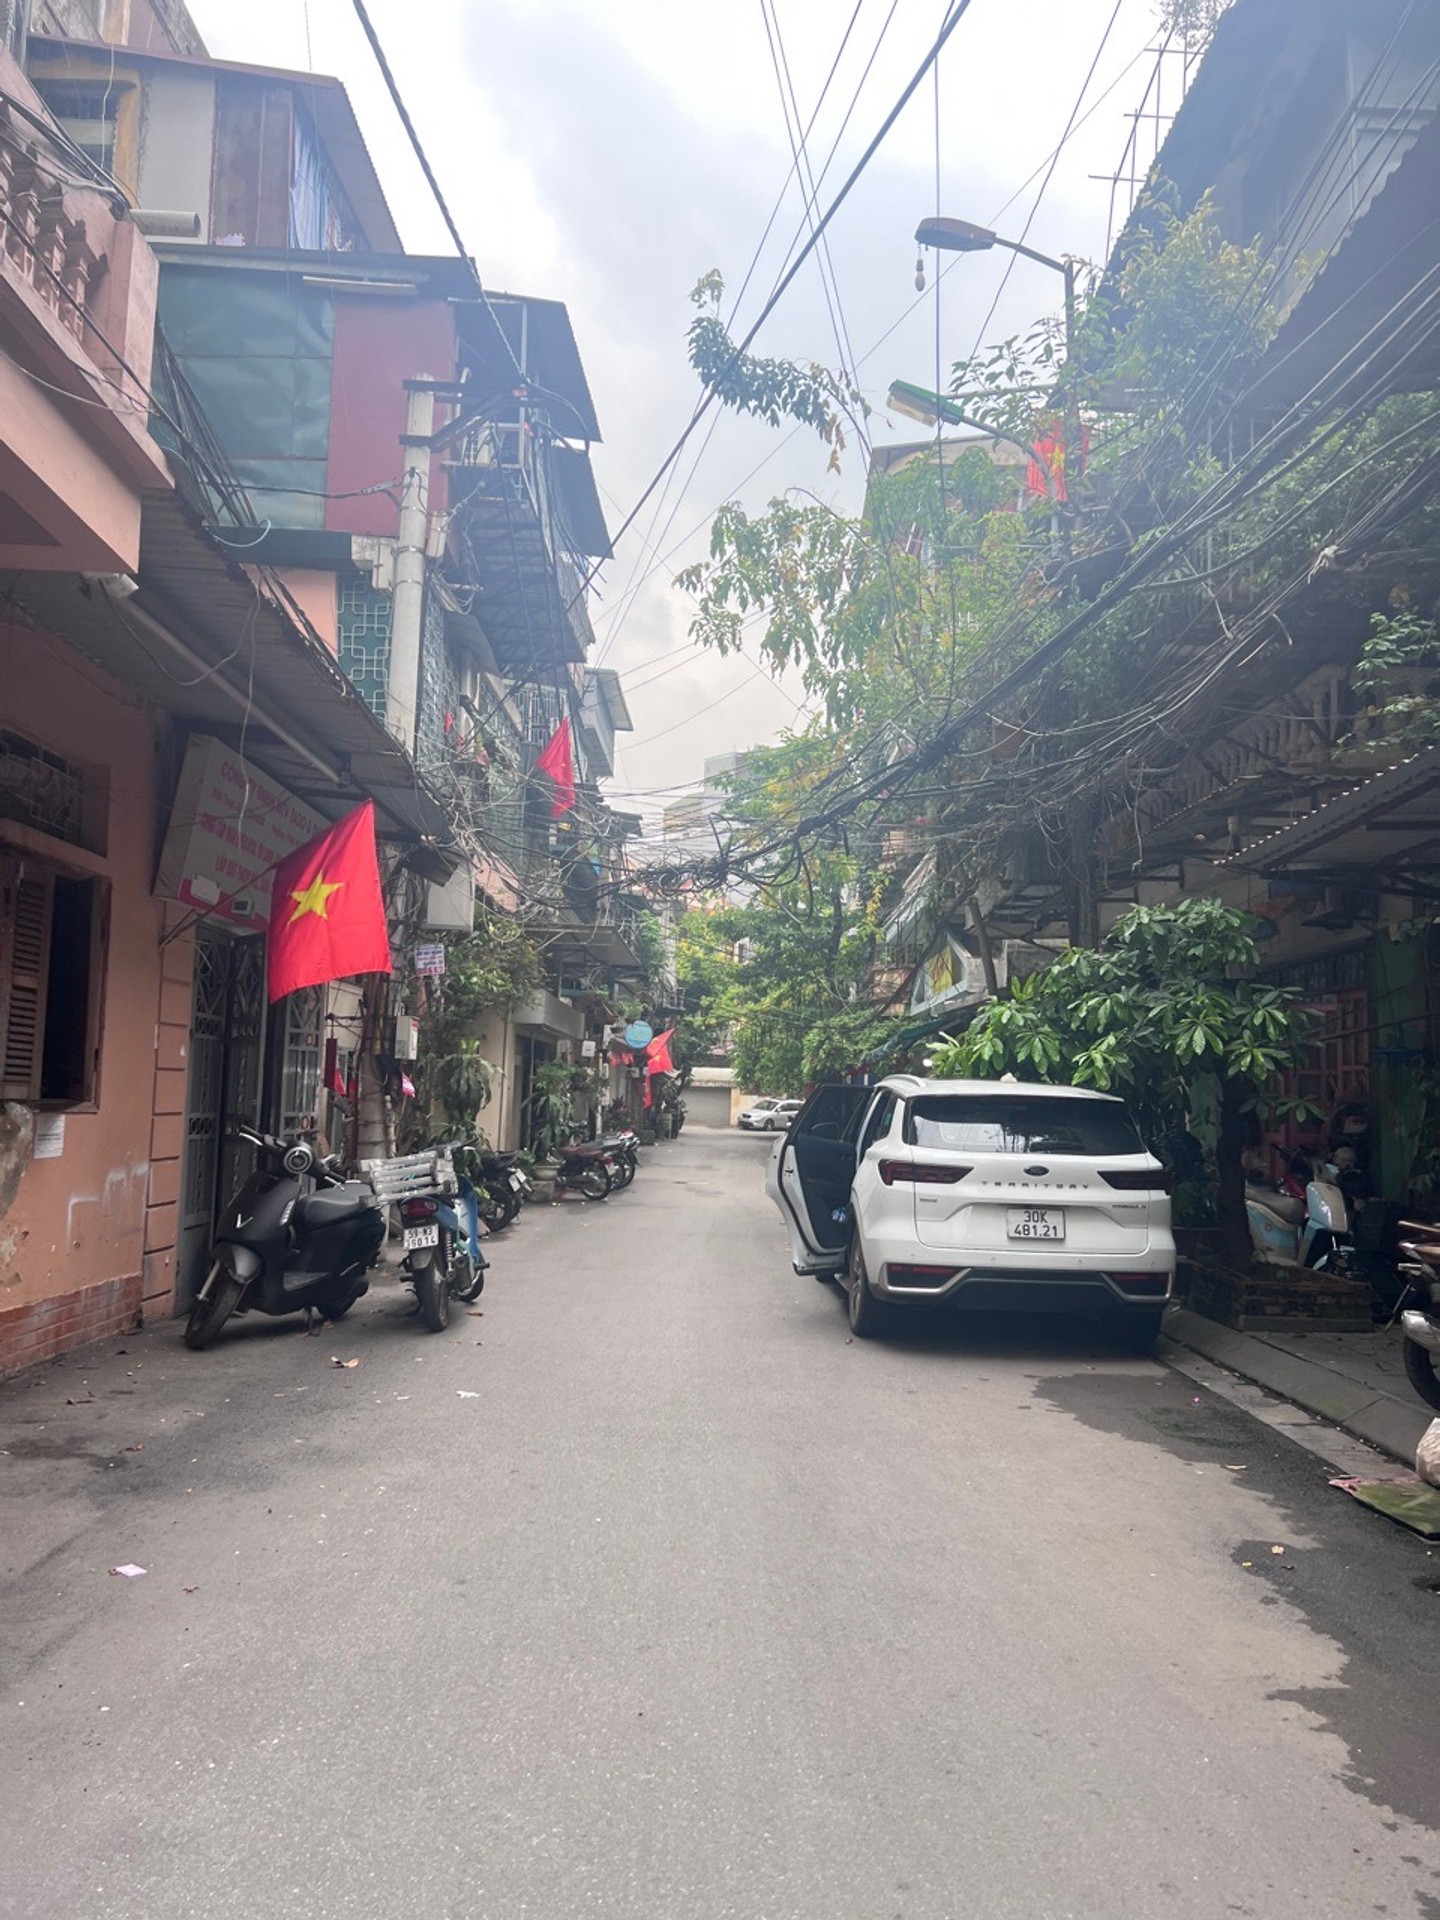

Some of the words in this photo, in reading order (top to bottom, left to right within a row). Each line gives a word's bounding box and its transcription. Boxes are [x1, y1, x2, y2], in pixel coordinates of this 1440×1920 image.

[981, 1180, 1088, 1189] TERRITORY
[1024, 1210, 1049, 1224] 30K
[1014, 1224, 1057, 1237] 481.21
